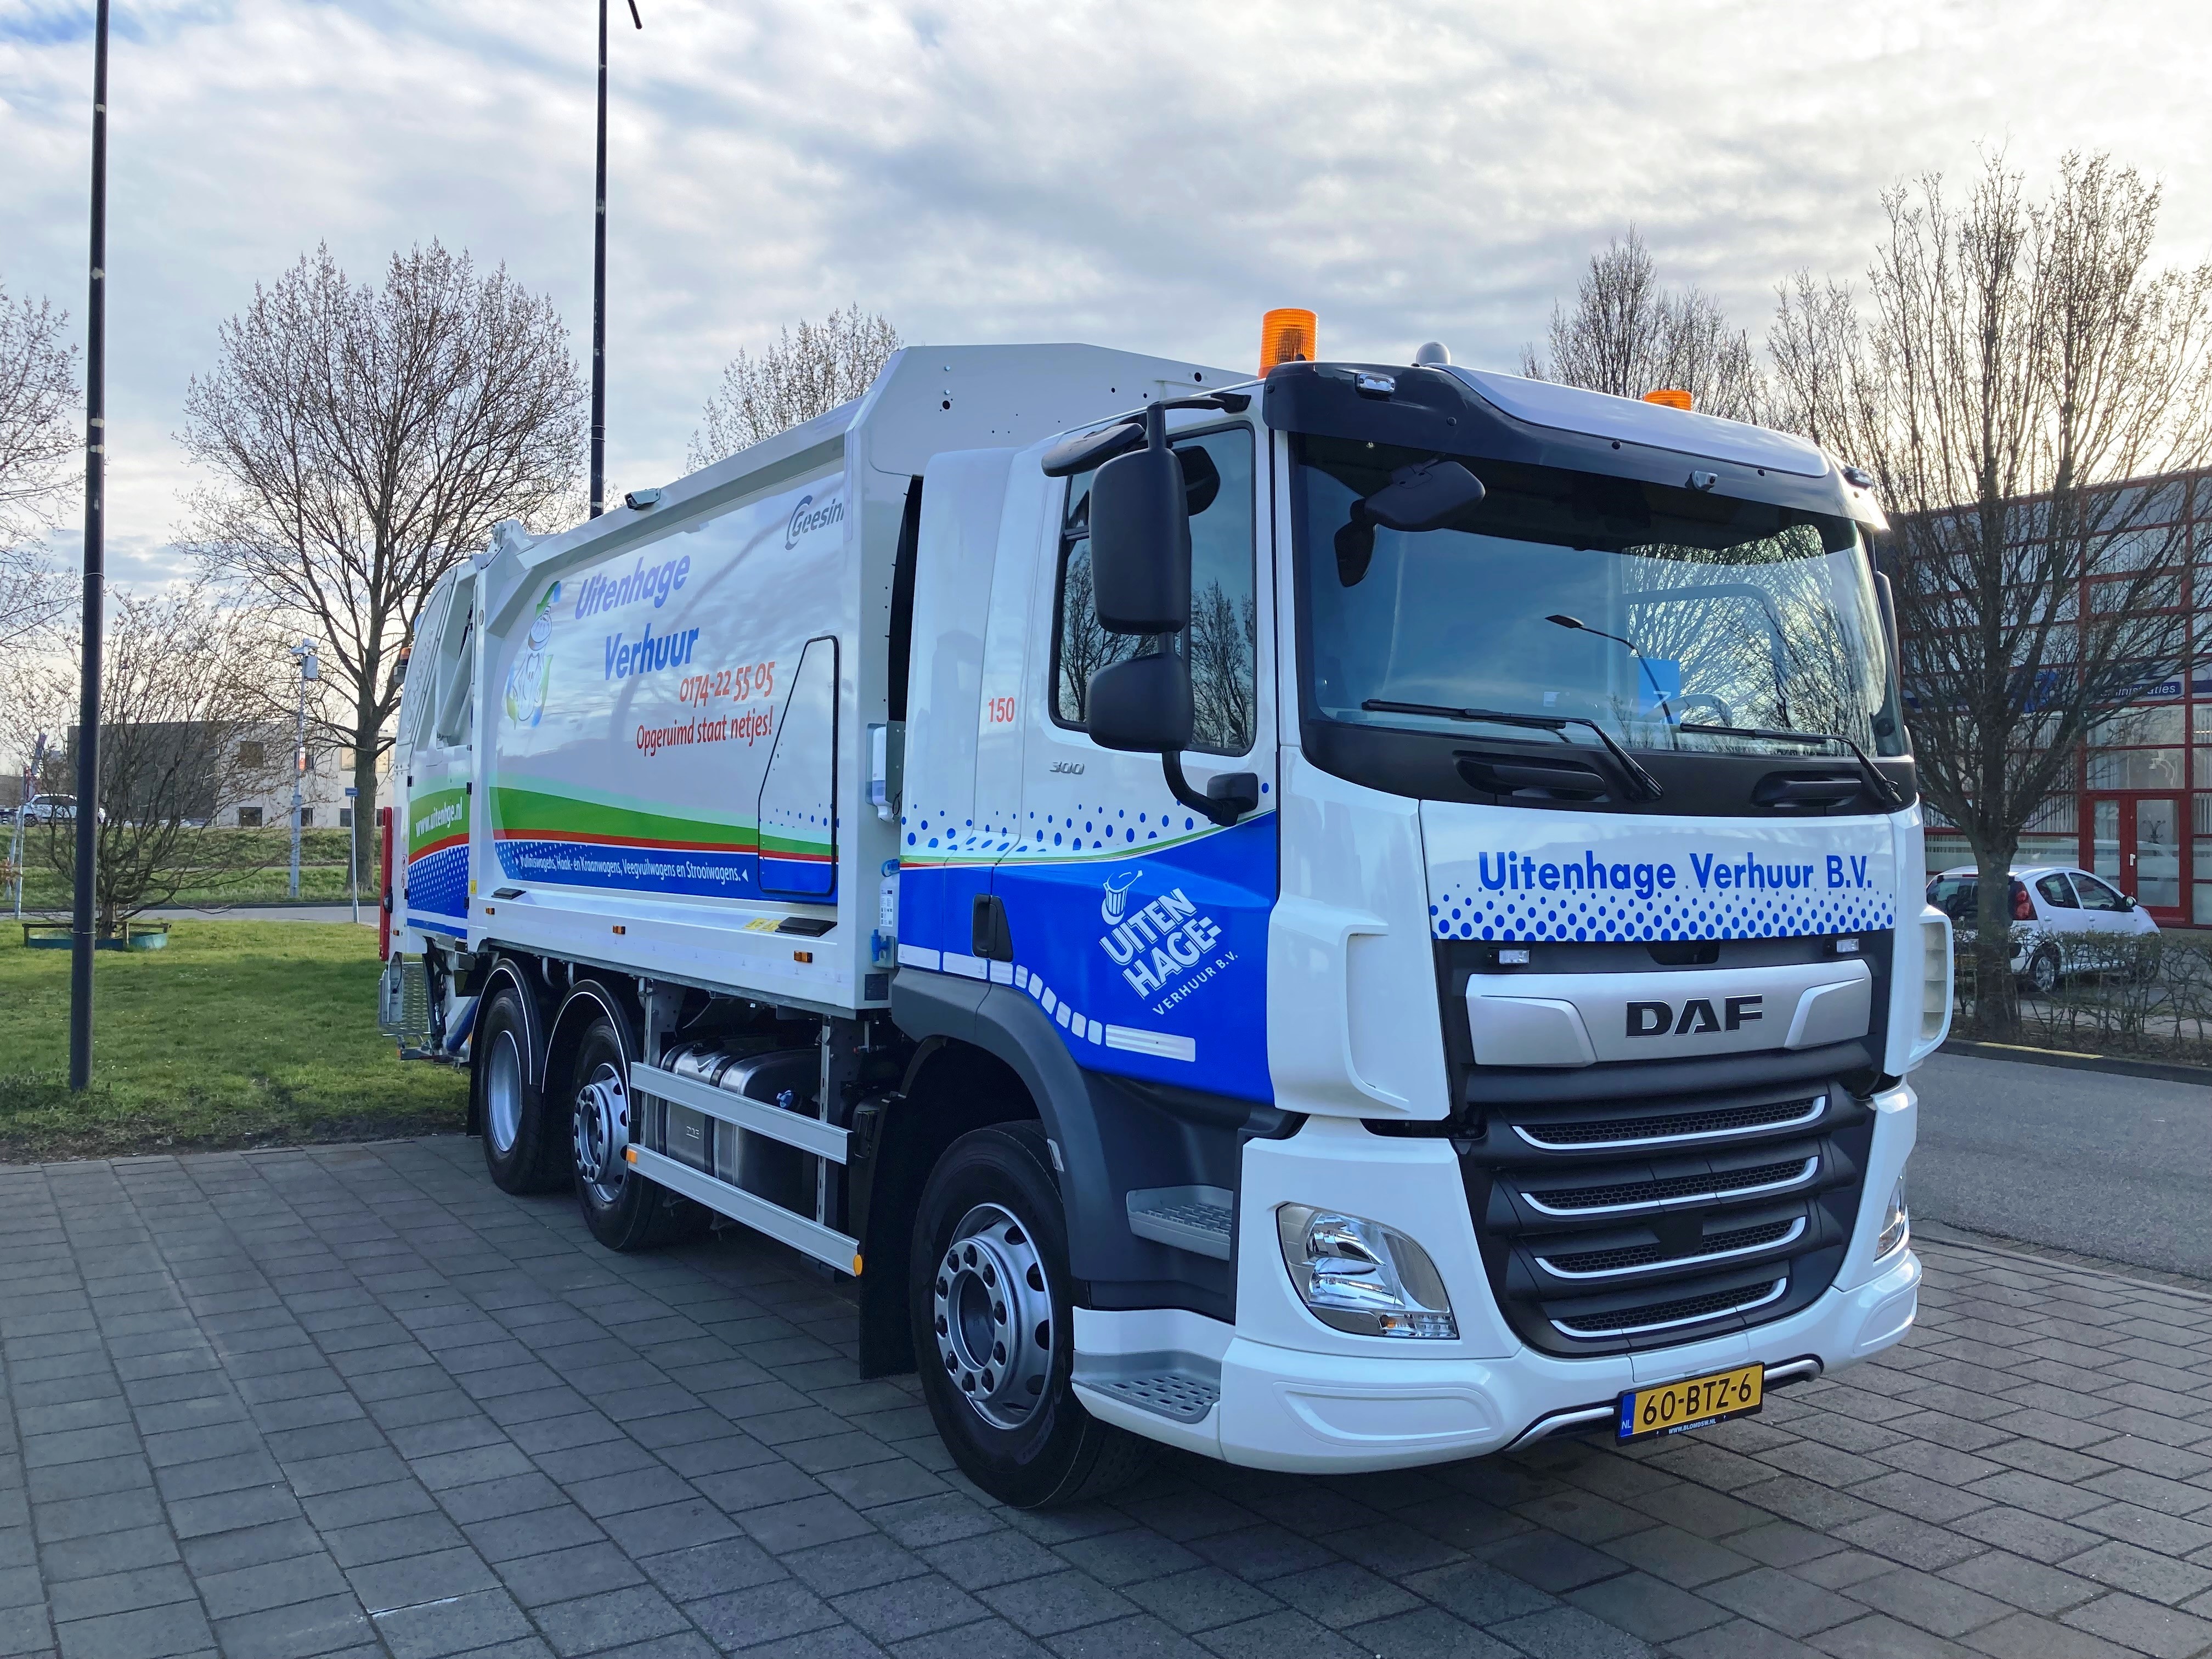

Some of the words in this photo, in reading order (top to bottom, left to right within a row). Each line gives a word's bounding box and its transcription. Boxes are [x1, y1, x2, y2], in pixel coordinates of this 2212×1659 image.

[786, 495, 844, 548] Geesin
[575, 555, 690, 620] Uitenhage
[605, 623, 699, 681] Verhuur
[680, 669, 731, 708] 0174-22
[733, 665, 752, 702] 55
[755, 662, 775, 697] 05
[989, 697, 1015, 723] 150
[636, 716, 695, 757] Opgeruimd
[697, 714, 727, 743] staat
[731, 706, 774, 747] netjes!
[1049, 761, 1085, 775] 300
[415, 796, 462, 838] www.uitenhge.nl
[557, 854, 573, 871] Haak-
[580, 856, 623, 877] Kraanwagens,
[622, 858, 676, 881] Veegvuilwagens
[676, 866, 686, 878] en
[686, 861, 741, 885] Strooiwagens.
[1479, 850, 1675, 899] Uitenhage
[1689, 853, 1814, 889] Verhuur
[1827, 855, 1872, 889] B.V.
[1099, 887, 1198, 966] UITEN
[1152, 966, 1217, 1015] VERHUUR
[1215, 950, 1238, 969] B.V.
[1626, 994, 1764, 1039] DAF
[1621, 1421, 1632, 1430] NL
[1643, 1373, 1752, 1425] 60-BTZ-6
